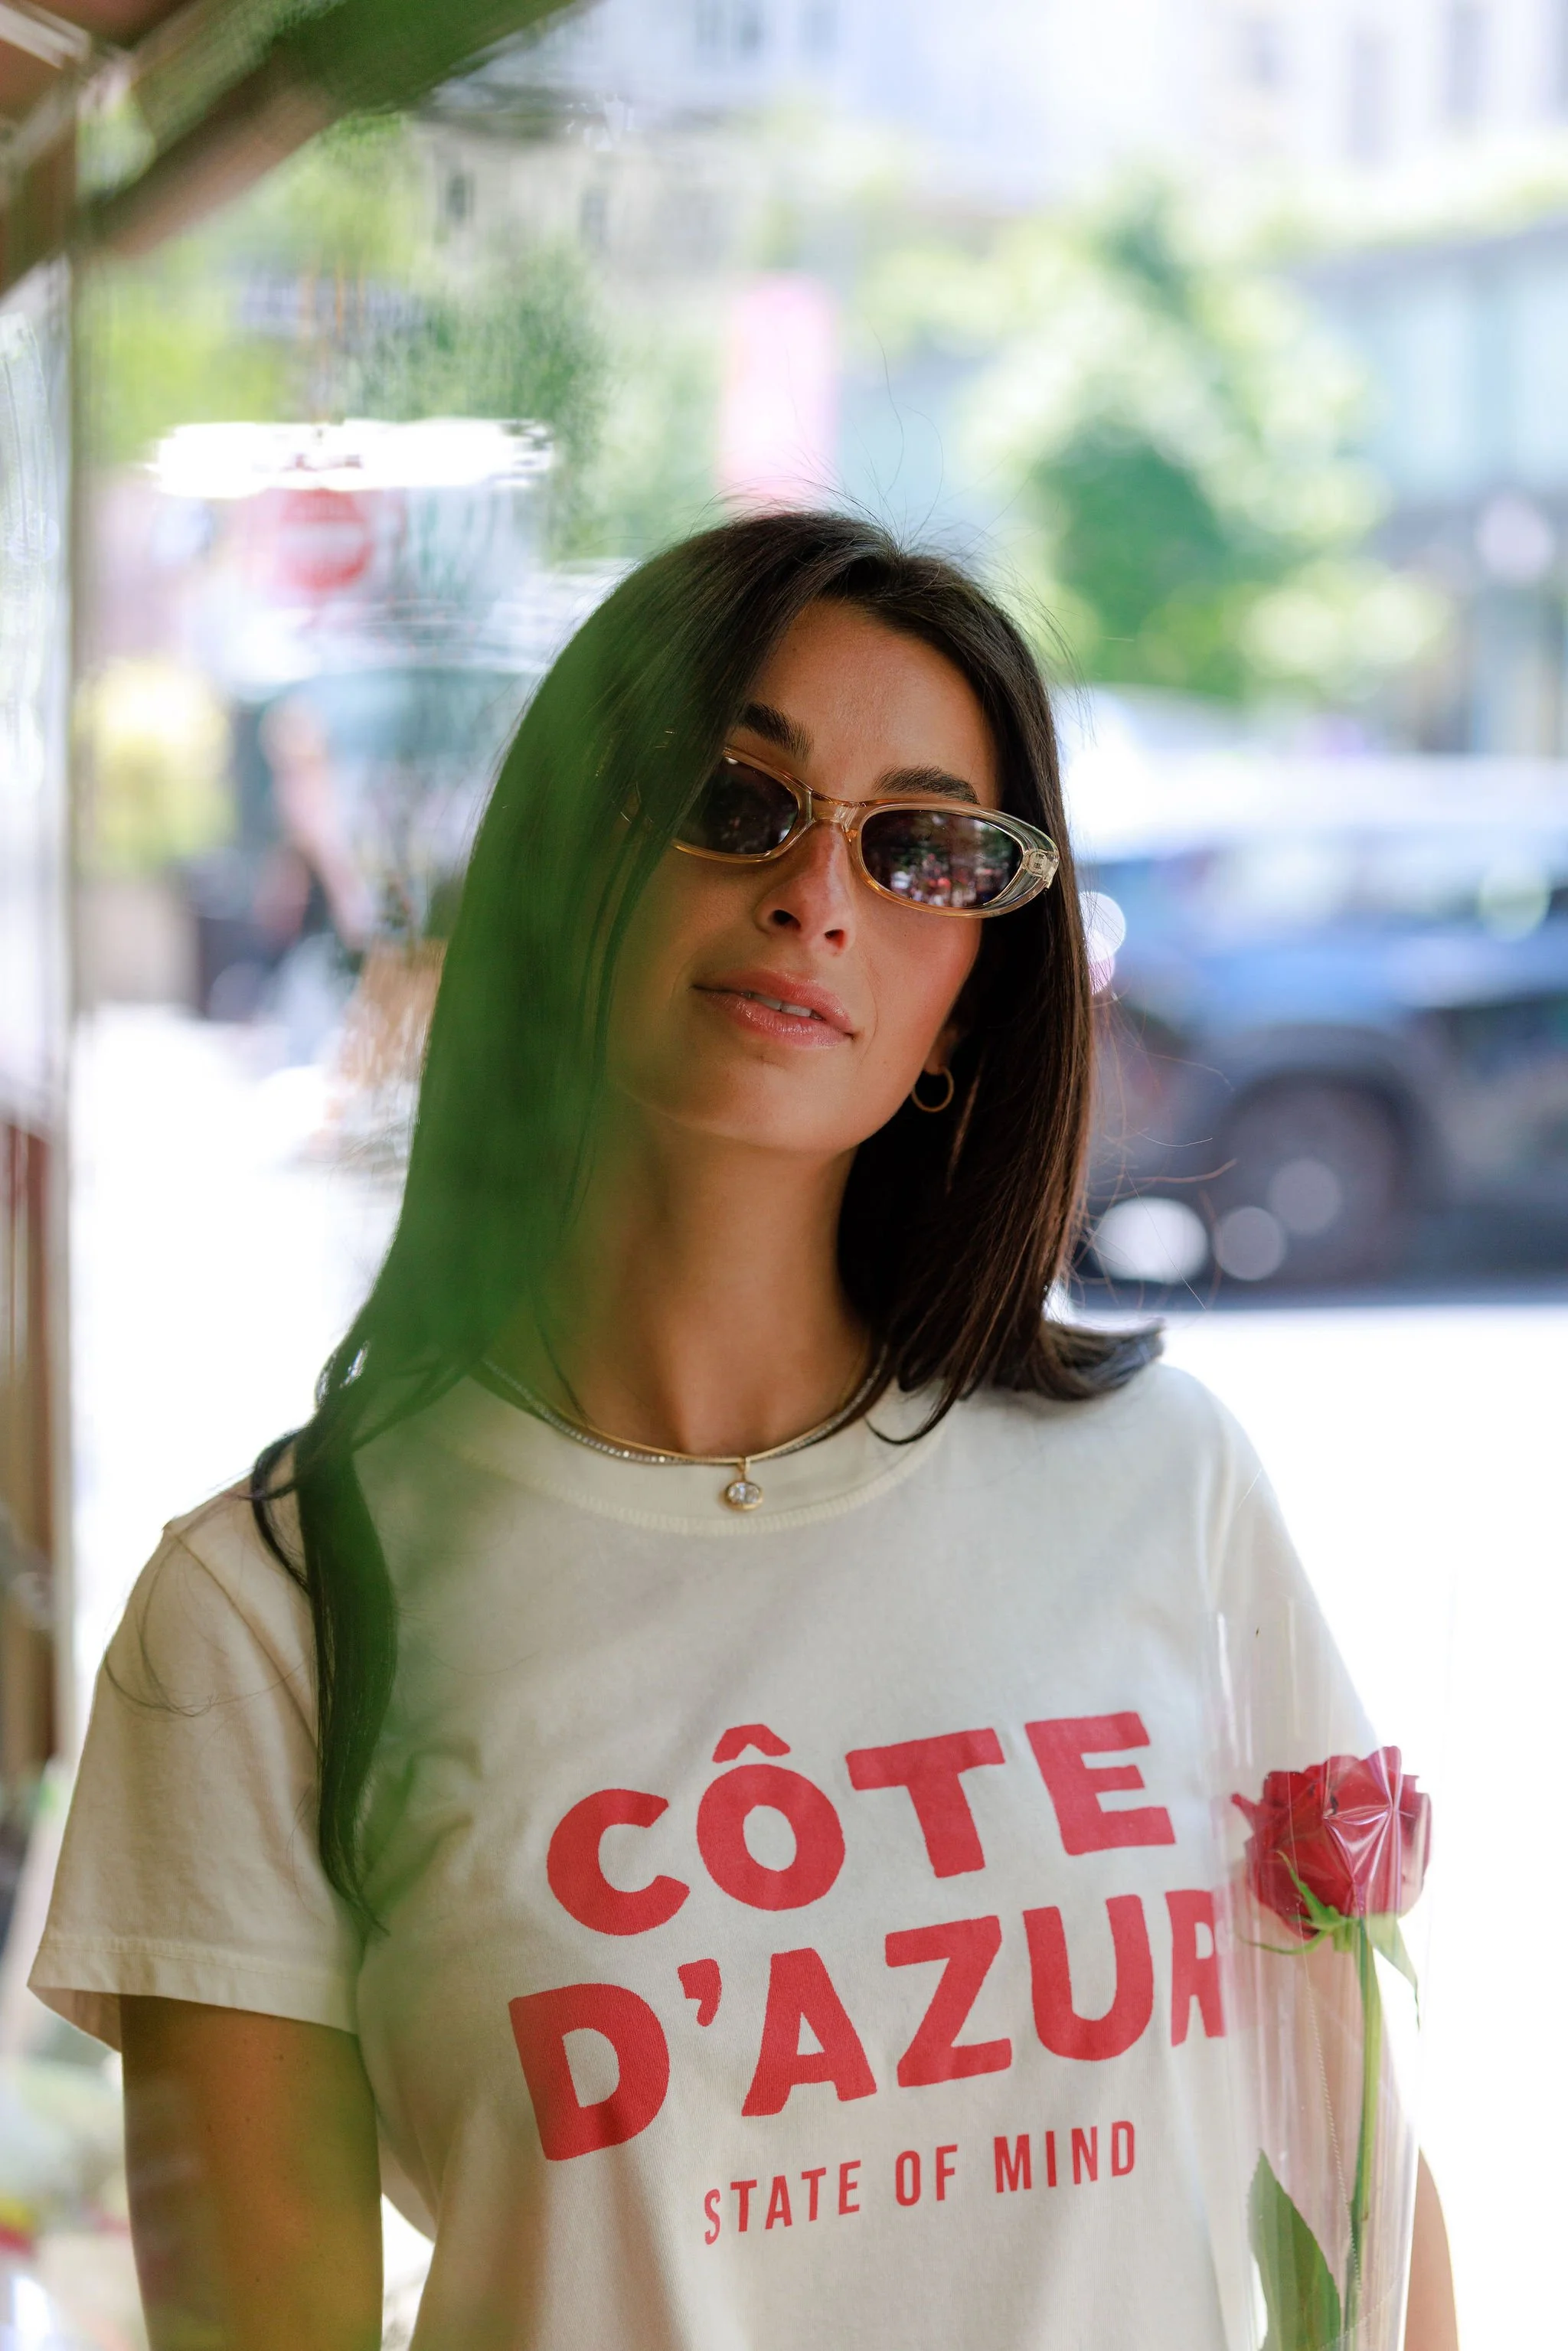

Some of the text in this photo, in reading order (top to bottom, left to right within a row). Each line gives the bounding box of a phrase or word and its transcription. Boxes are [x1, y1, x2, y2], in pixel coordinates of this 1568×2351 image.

[546, 1712, 1175, 1936] CÔTE
[510, 1890, 1227, 2162] D'AZUR
[704, 2121, 1136, 2245] STATE OF MIND
